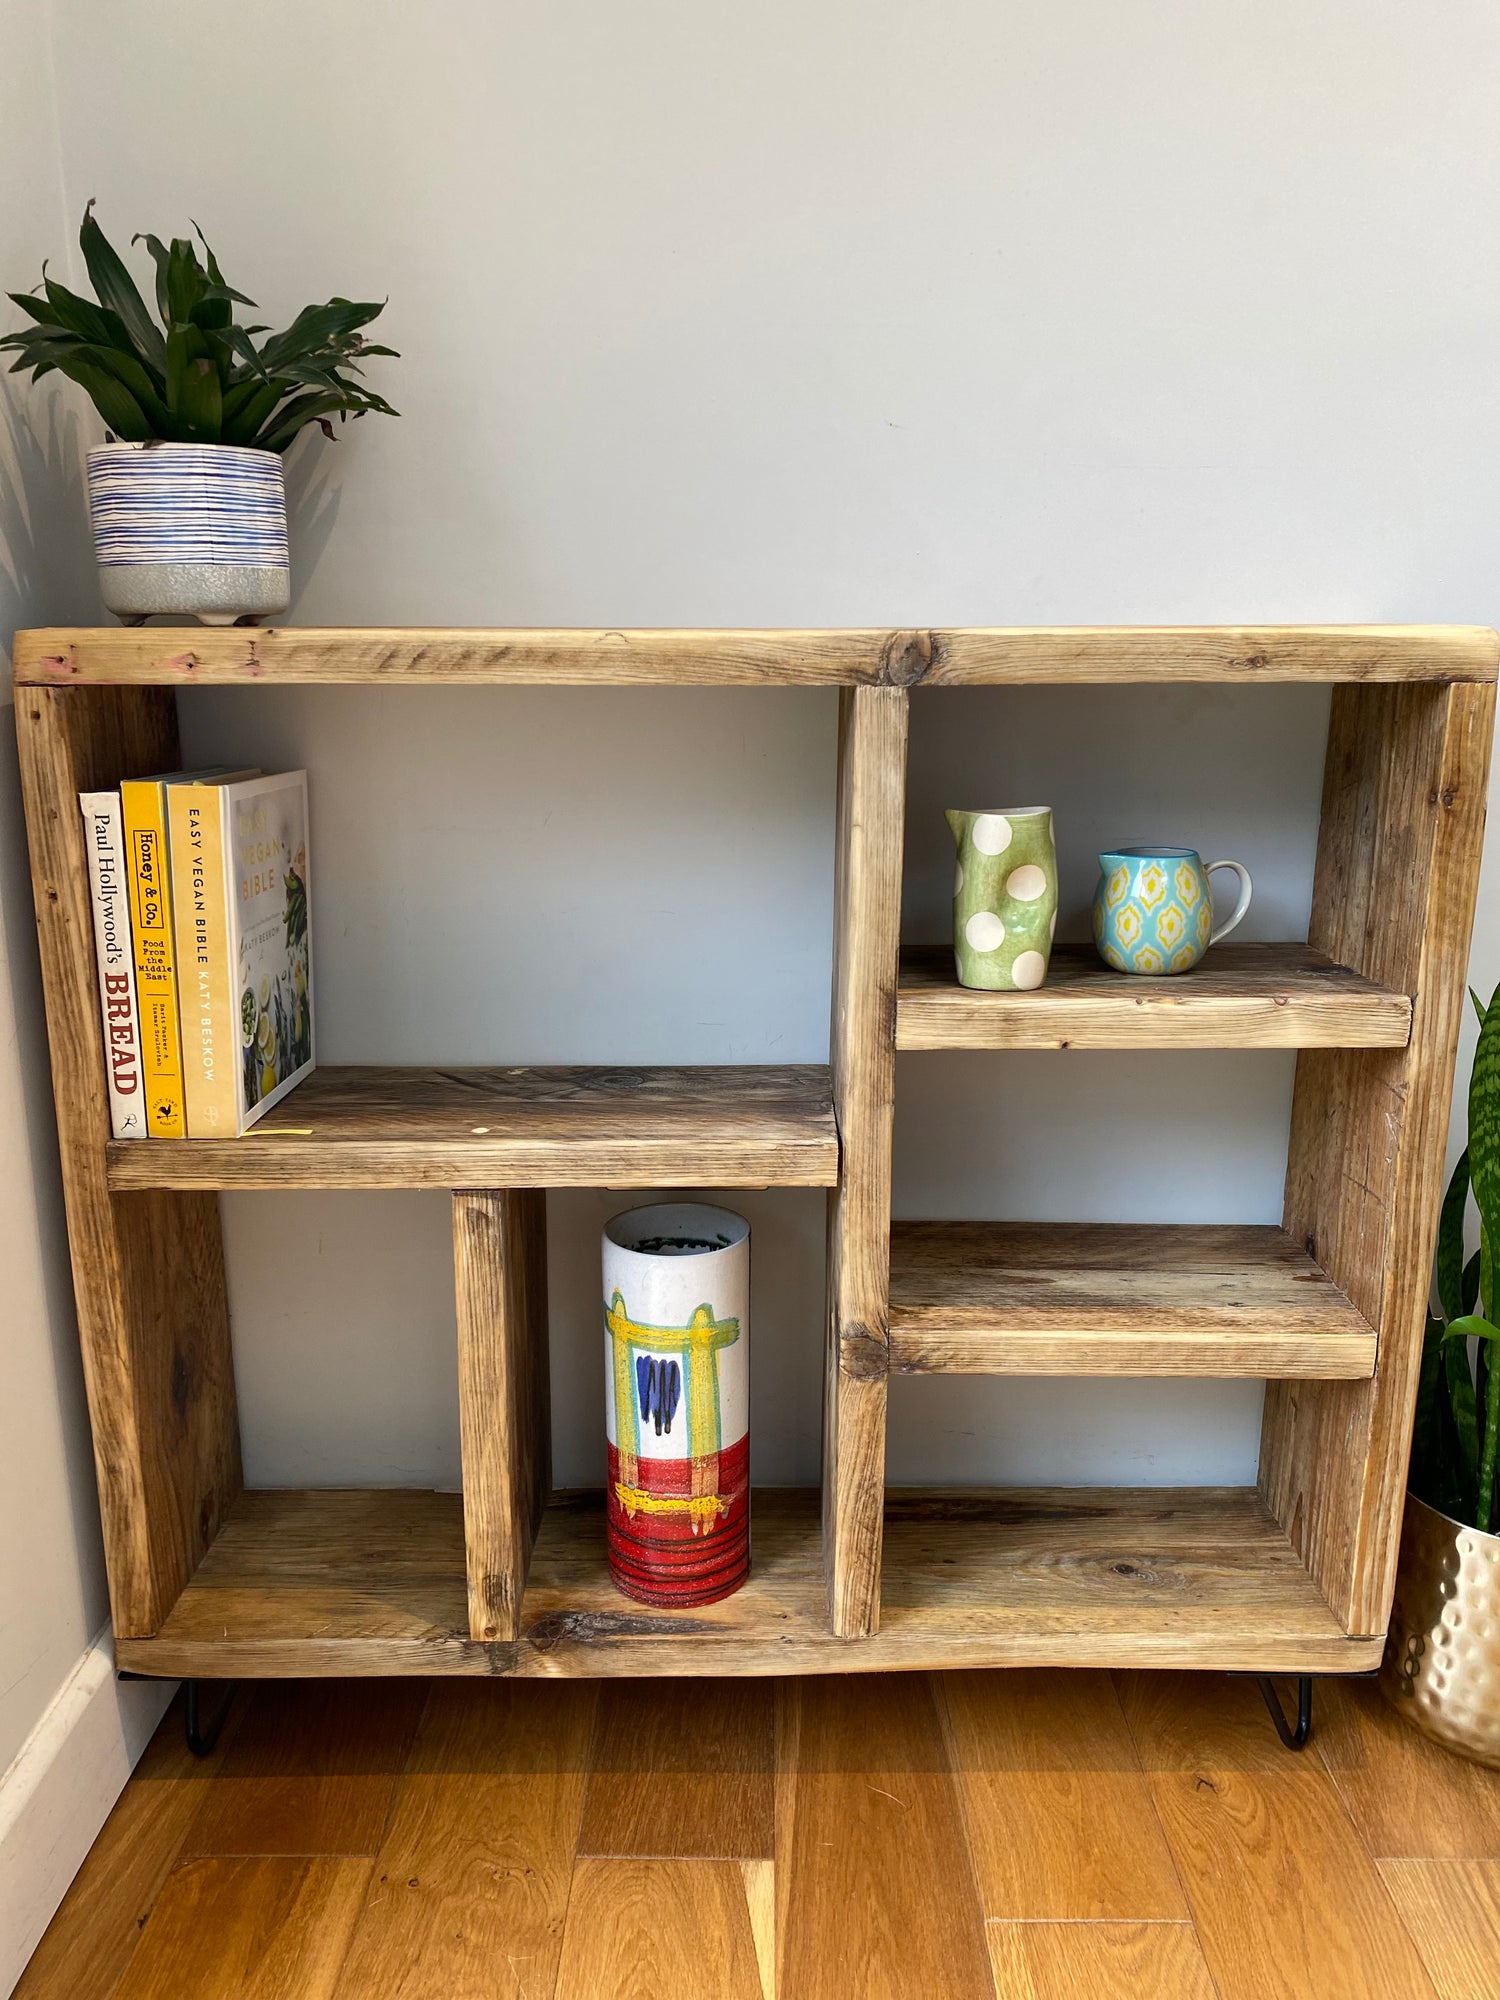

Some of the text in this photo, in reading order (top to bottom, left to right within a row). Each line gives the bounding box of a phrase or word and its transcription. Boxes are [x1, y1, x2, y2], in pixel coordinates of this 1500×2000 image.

[140, 833, 157, 925] Honey & Co.
[241, 838, 280, 866] VEGAN
[243, 868, 275, 900] BIBLE
[94, 814, 138, 1095] Paul Hollywood's BREAD
[143, 948, 165, 956] From
[190, 809, 215, 1081] EASY VEGAN BIBLE KATY BESKOW
